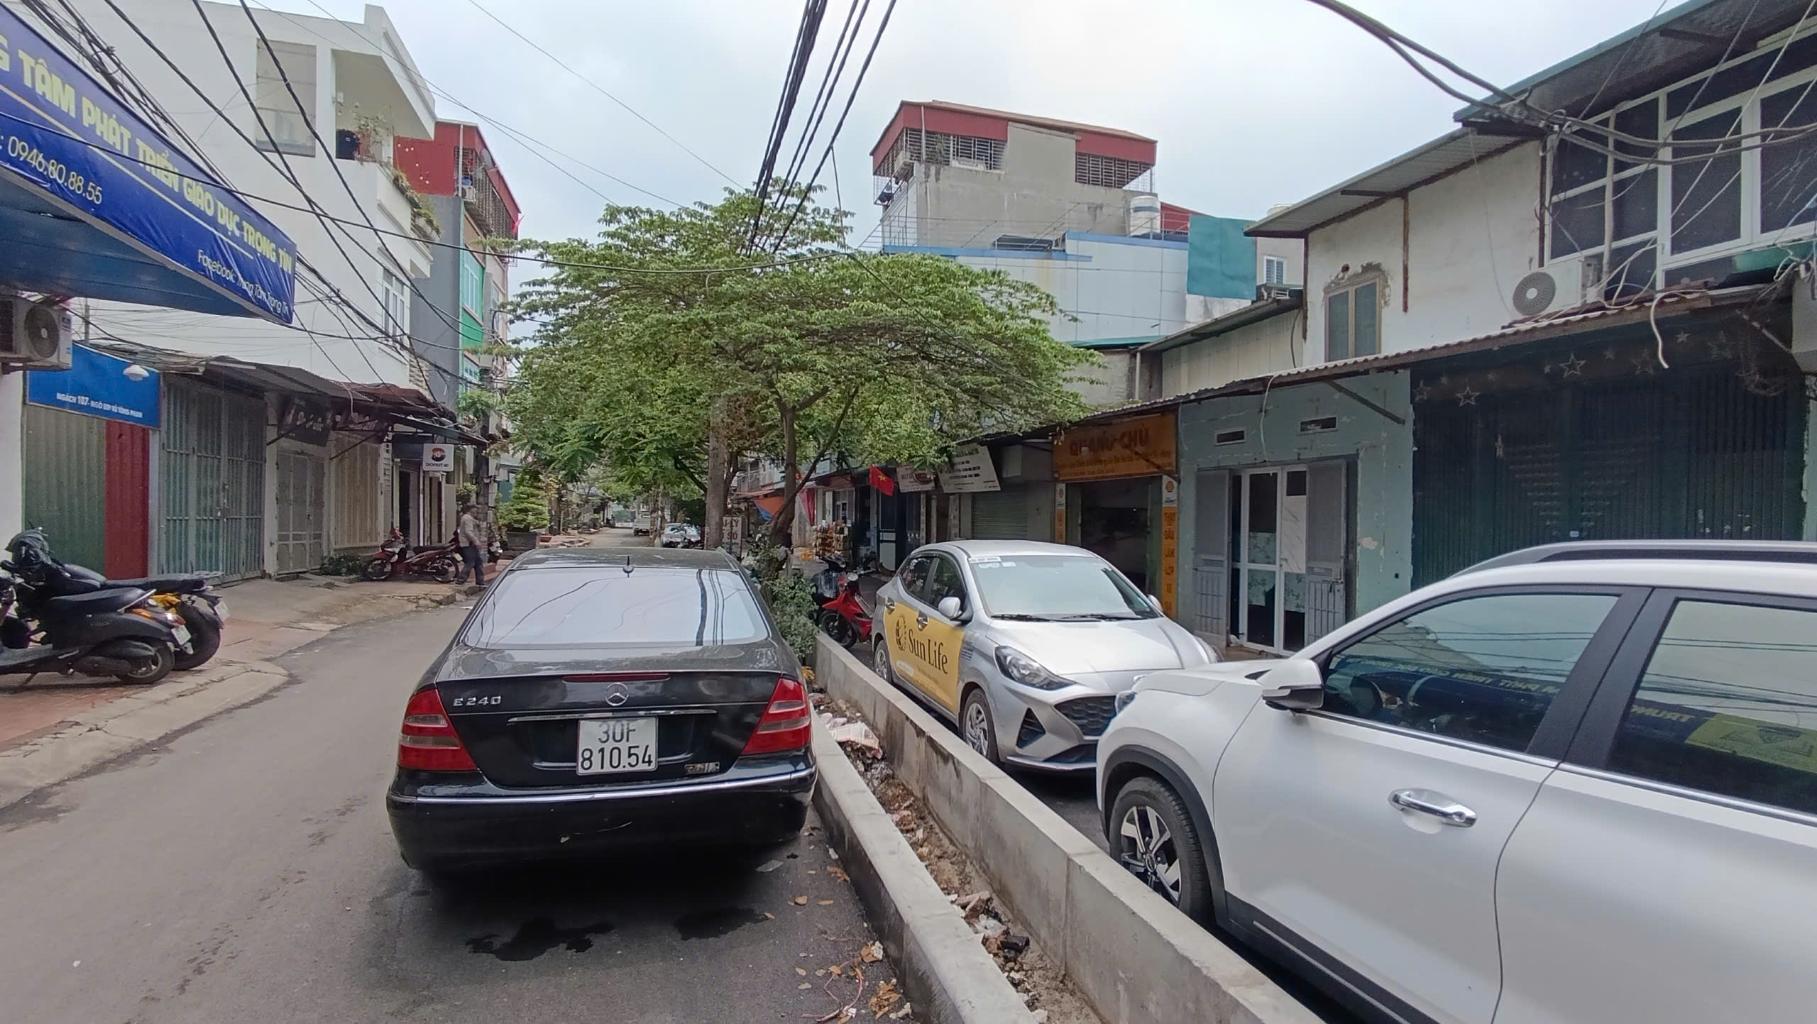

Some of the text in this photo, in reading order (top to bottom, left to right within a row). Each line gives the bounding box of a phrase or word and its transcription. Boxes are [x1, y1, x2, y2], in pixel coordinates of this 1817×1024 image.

[18, 49, 76, 118] TÂM
[82, 95, 131, 156] PHÁT
[136, 138, 179, 192] TRIỂN
[183, 178, 214, 217] GIÁO
[216, 200, 240, 236] DỤC
[242, 220, 276, 263] TRỌNG
[278, 248, 293, 274] TÍN
[908, 629, 926, 662] Sun
[928, 638, 949, 675] Life
[453, 695, 501, 706] E 240
[598, 720, 636, 744] 30F
[580, 744, 653, 770] 810.54
